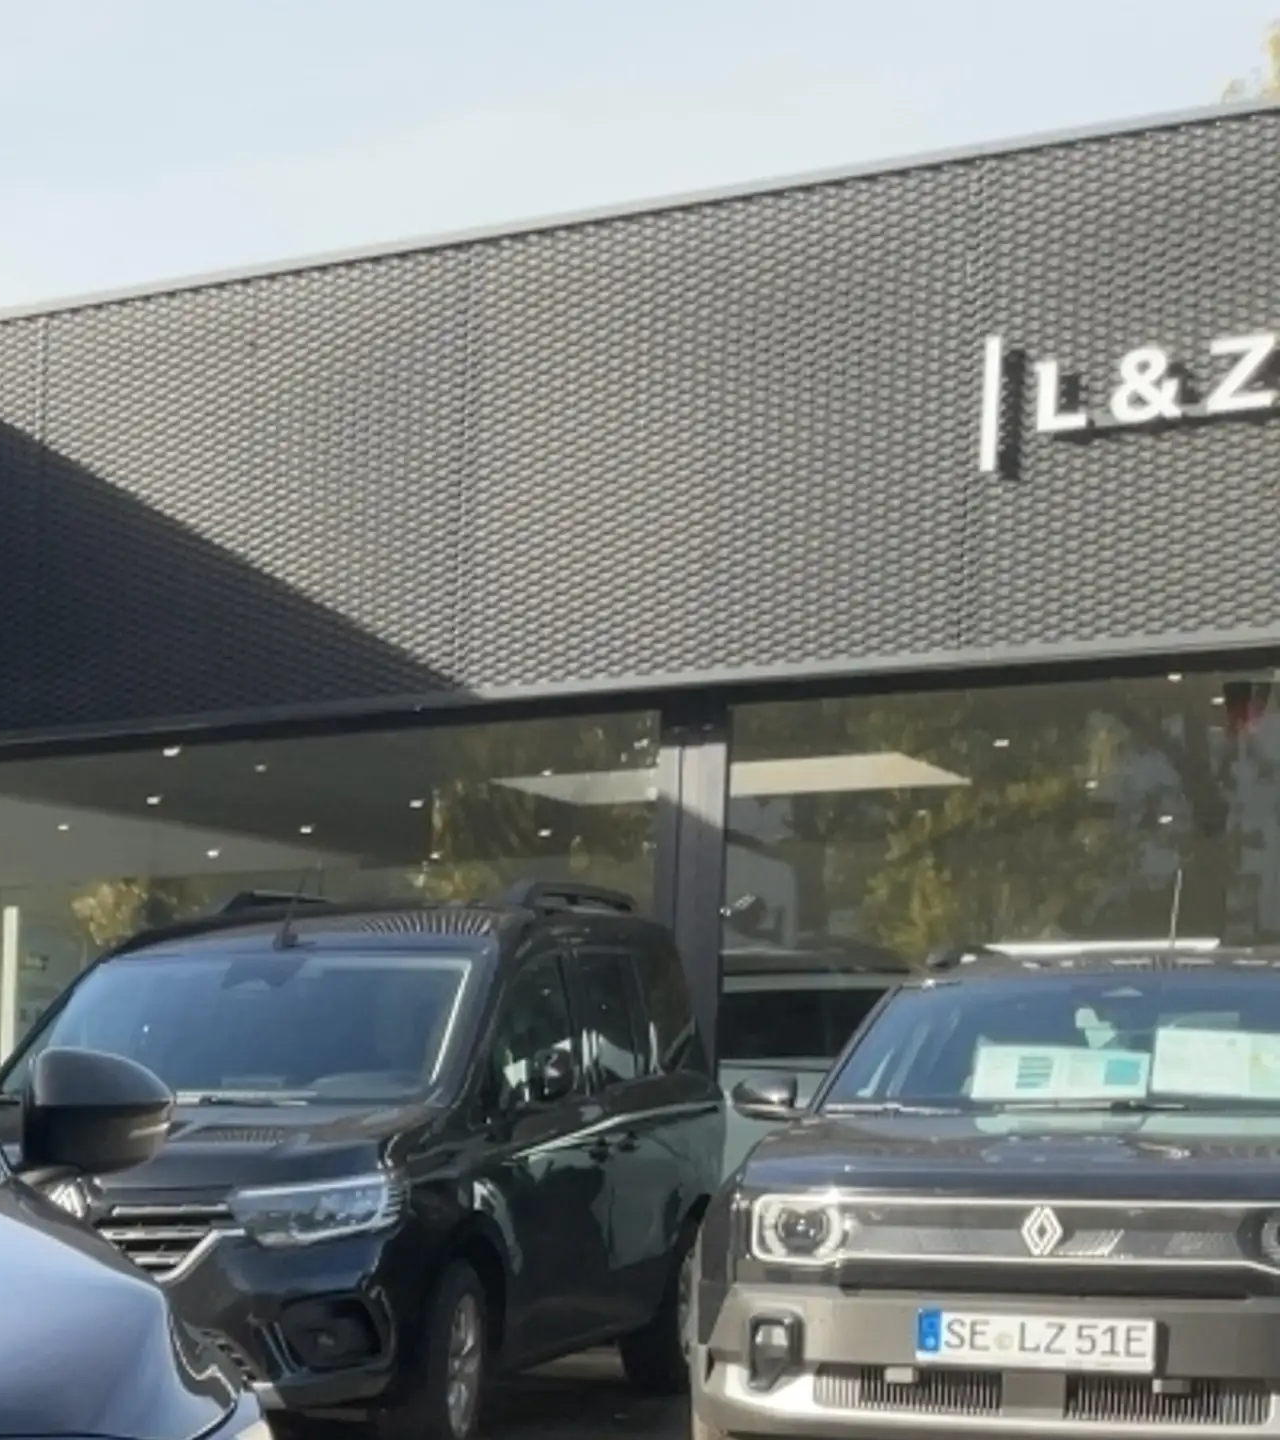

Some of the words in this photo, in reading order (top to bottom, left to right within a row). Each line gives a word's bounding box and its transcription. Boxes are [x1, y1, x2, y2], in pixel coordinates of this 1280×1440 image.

[944, 1318, 991, 1351] SE
[1018, 1321, 1067, 1355] LZ
[1075, 1324, 1148, 1358] 51E
